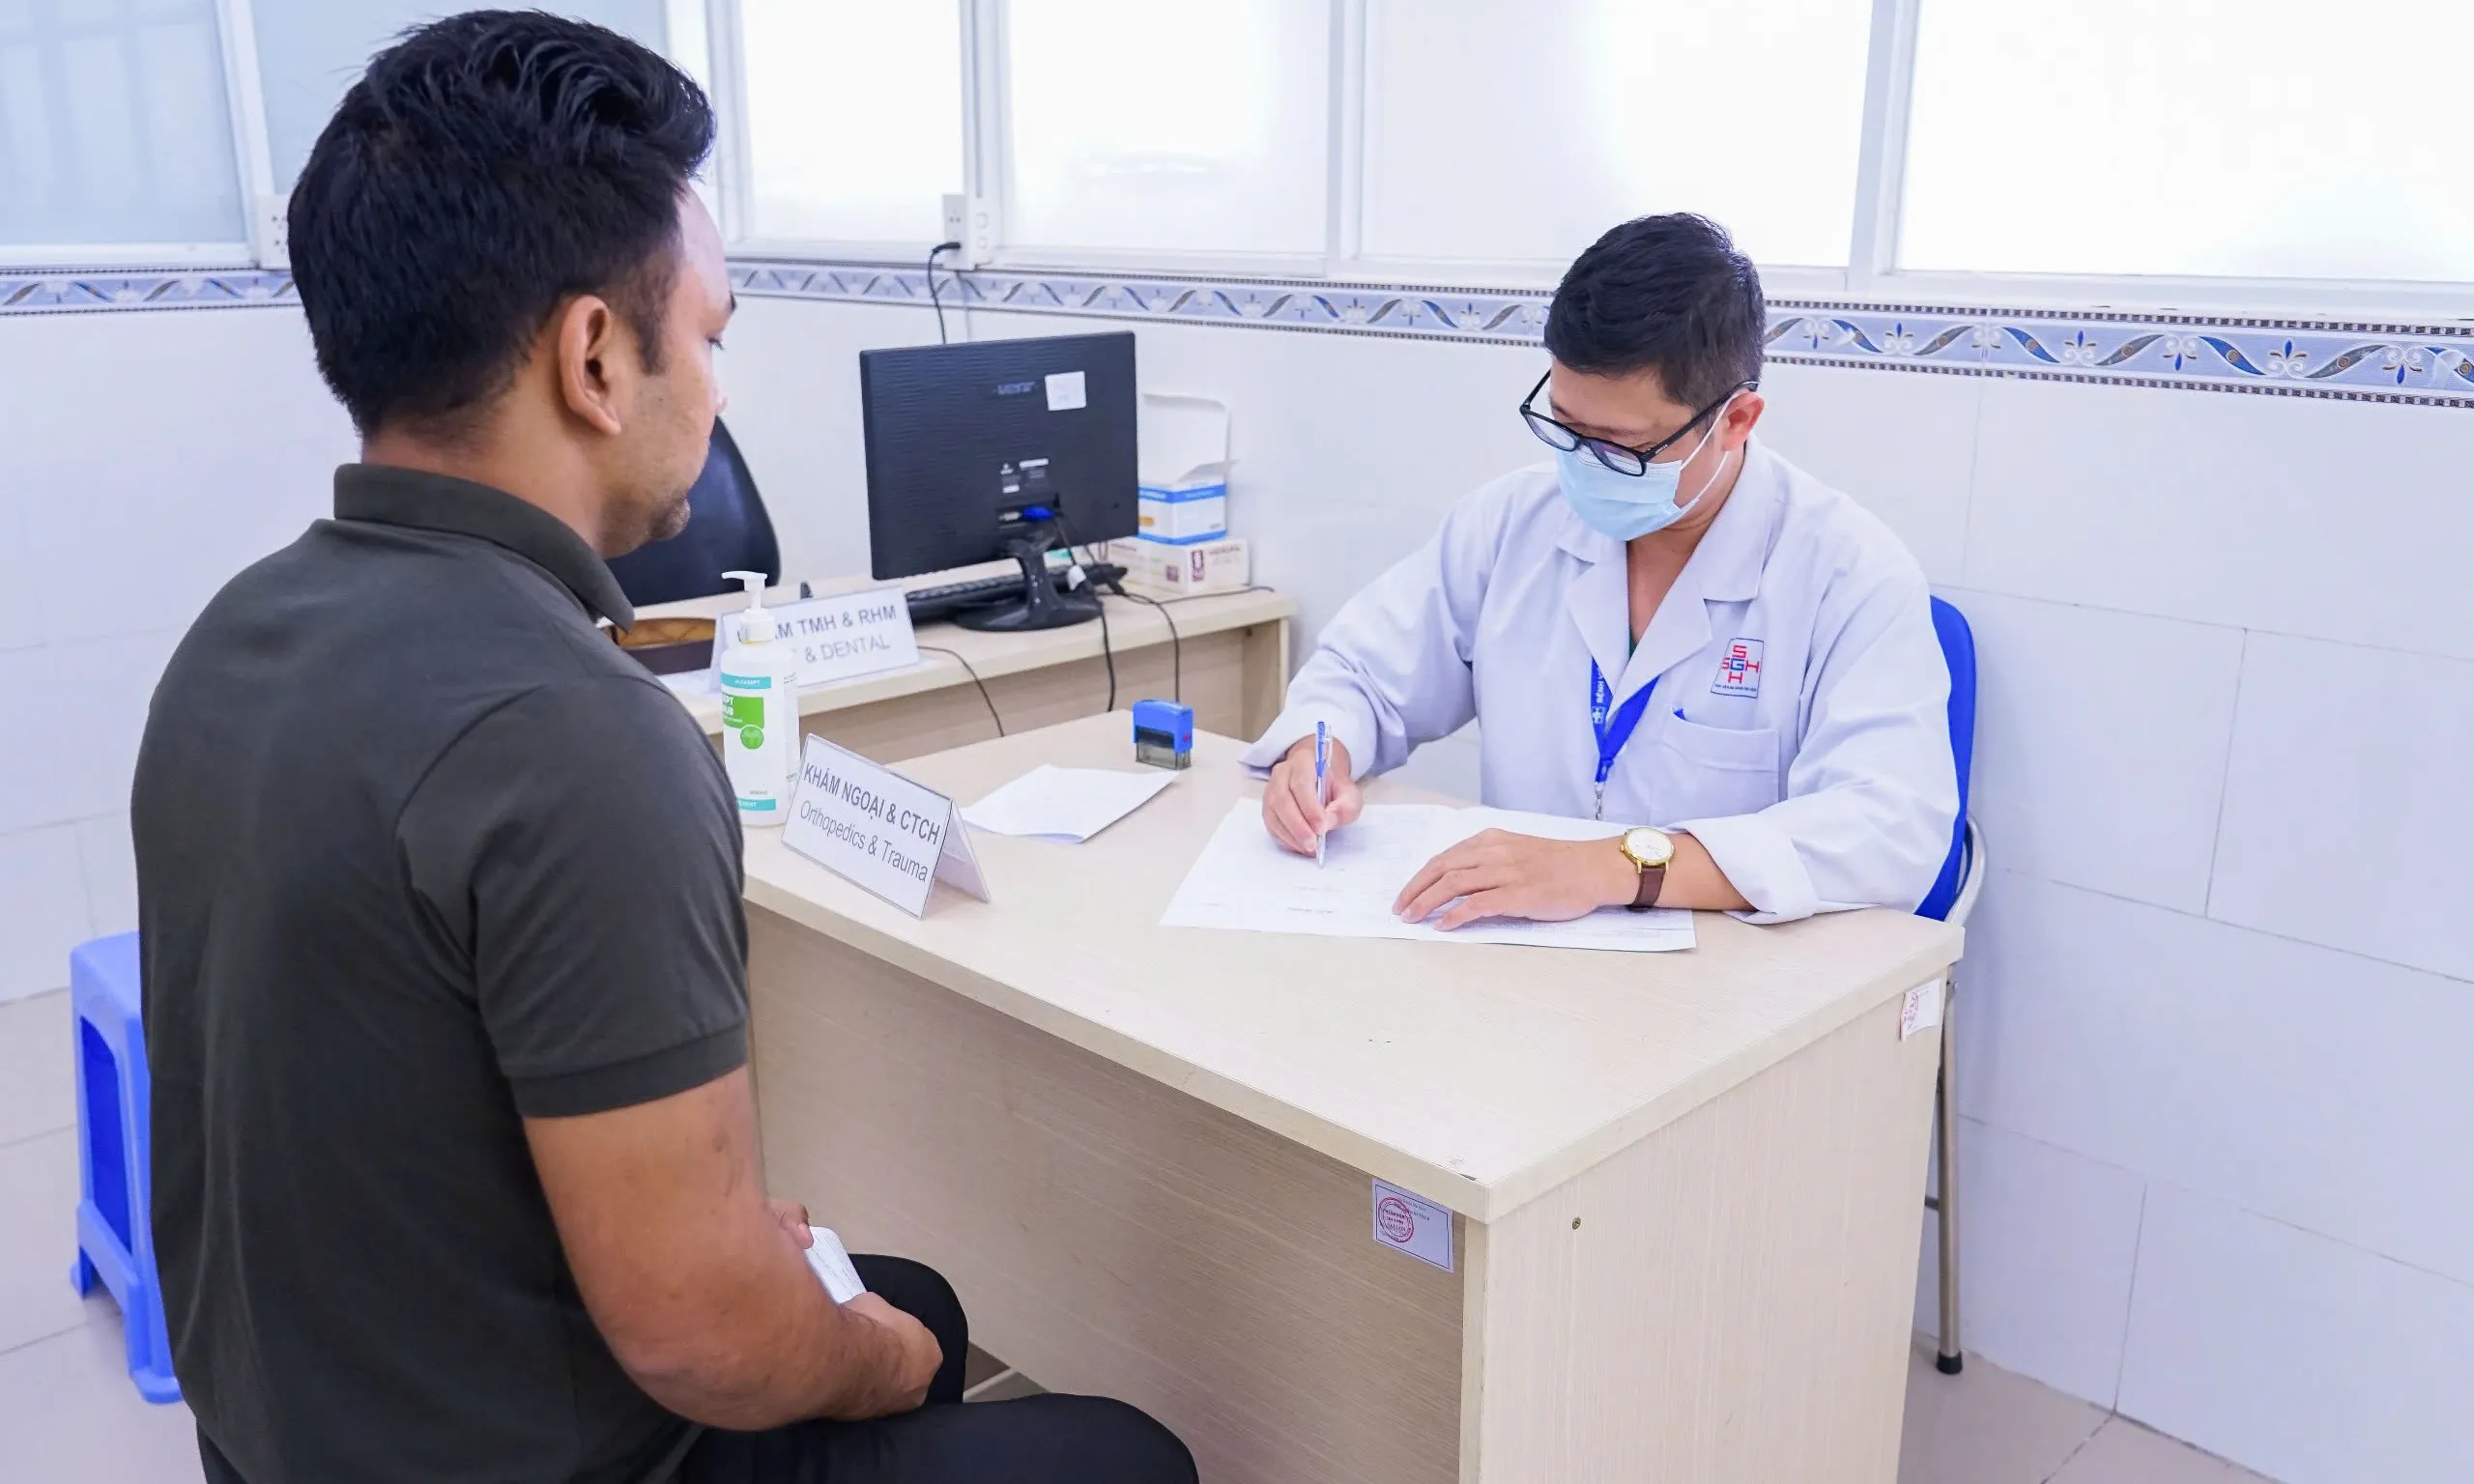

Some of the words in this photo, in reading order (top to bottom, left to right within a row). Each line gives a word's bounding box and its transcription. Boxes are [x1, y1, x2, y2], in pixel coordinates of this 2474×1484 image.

[796, 614, 837, 635] TMH
[842, 611, 854, 628] &
[858, 605, 897, 624] RHM
[804, 646, 817, 663] &
[820, 634, 891, 661] DENTAL
[804, 762, 841, 796] KHÁM
[842, 782, 885, 820] NGOẠI
[886, 803, 897, 824] &
[901, 811, 940, 845] CTCH
[800, 800, 866, 849] Orthopedics
[868, 835, 878, 857] &
[881, 840, 929, 883] Trauma
